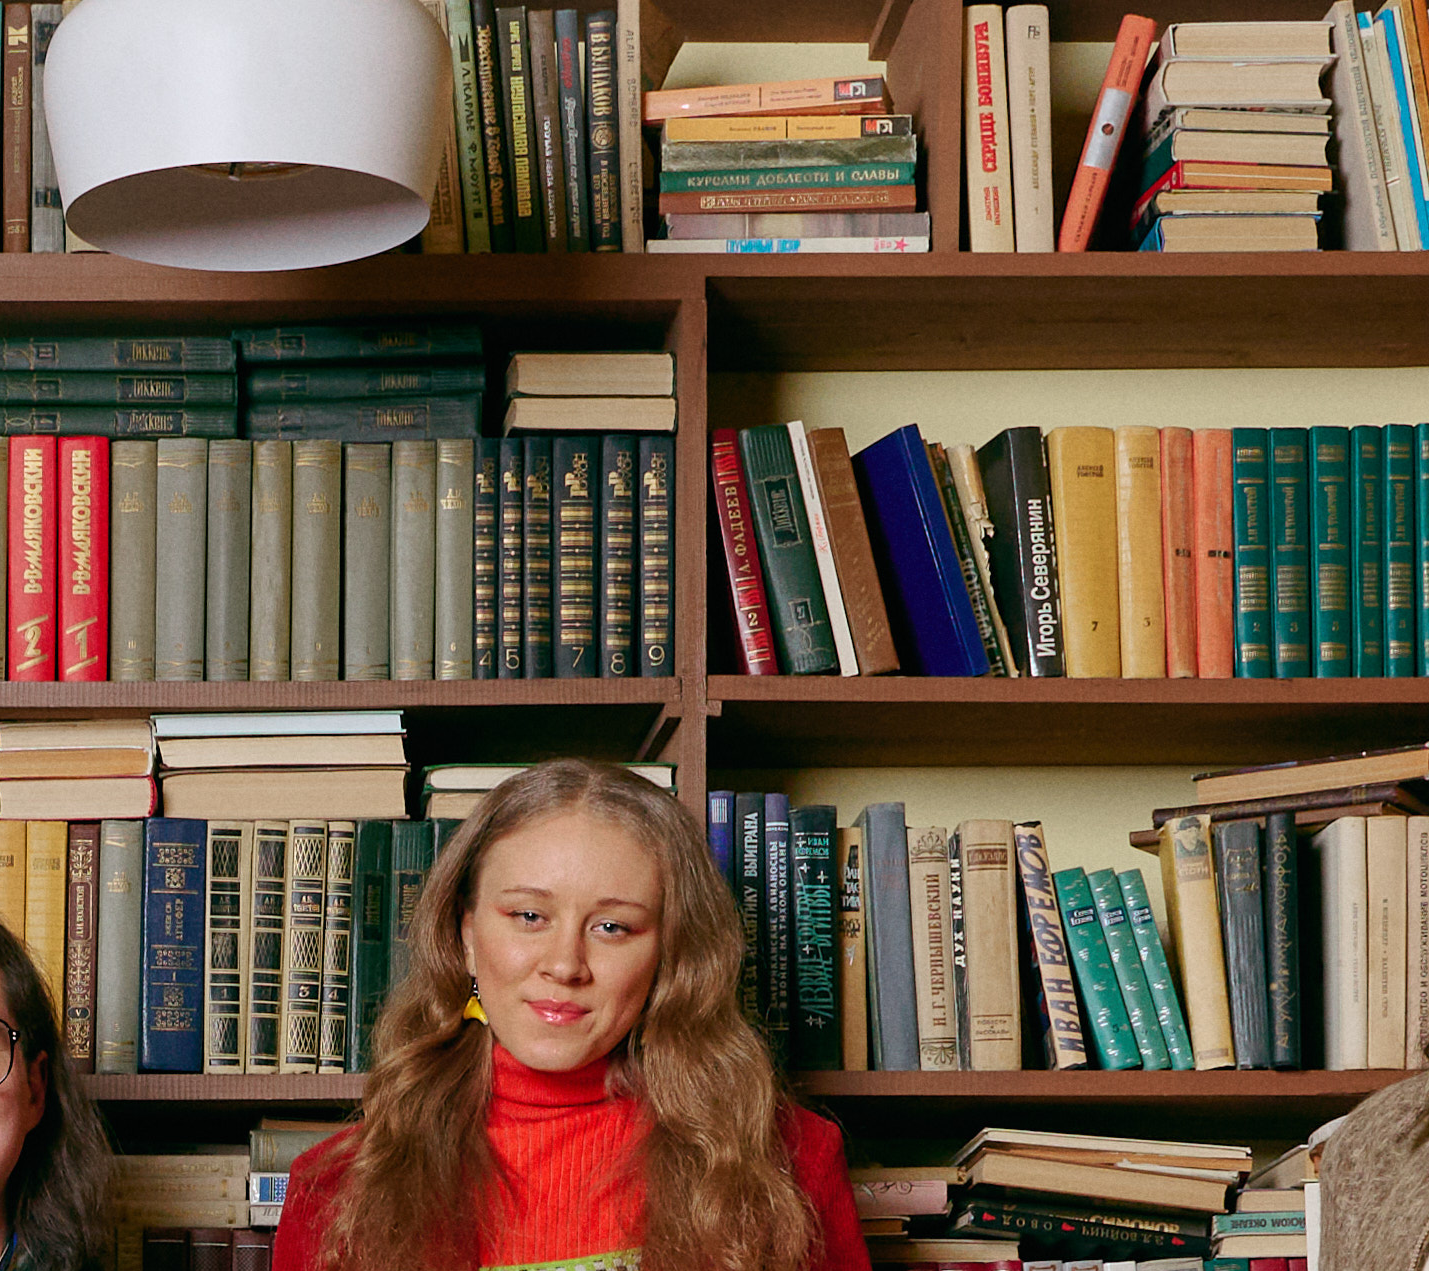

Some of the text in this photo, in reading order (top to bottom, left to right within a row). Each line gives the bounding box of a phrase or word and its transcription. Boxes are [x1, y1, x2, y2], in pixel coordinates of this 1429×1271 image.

[591, 46, 613, 117] БУЛГАКОВ
[979, 112, 998, 173] СЕРДЦЕ
[687, 173, 751, 188] КУРСАМИ
[835, 170, 845, 182] И
[851, 168, 900, 181] СЛАВЫ
[725, 486, 747, 557] ФАДЕЕВ
[1028, 499, 1057, 657] Игорь Северянин
[24, 625, 42, 657] 2
[75, 626, 89, 659] 1
[572, 647, 584, 667] 7
[648, 645, 665, 666] 9
[479, 650, 491, 669] 4
[505, 649, 520, 669] 5
[611, 653, 626, 674] 8
[744, 812, 759, 877] ВЫИГРАНА
[950, 858, 966, 968] ДУХ НАУКИ
[926, 873, 944, 995] ЧЕРНЫШЕВСКИЙ
[1017, 832, 1086, 1053] ИВАН ЕФРЕМОВ
[1230, 1218, 1268, 1230] ОКЕАНЕ
